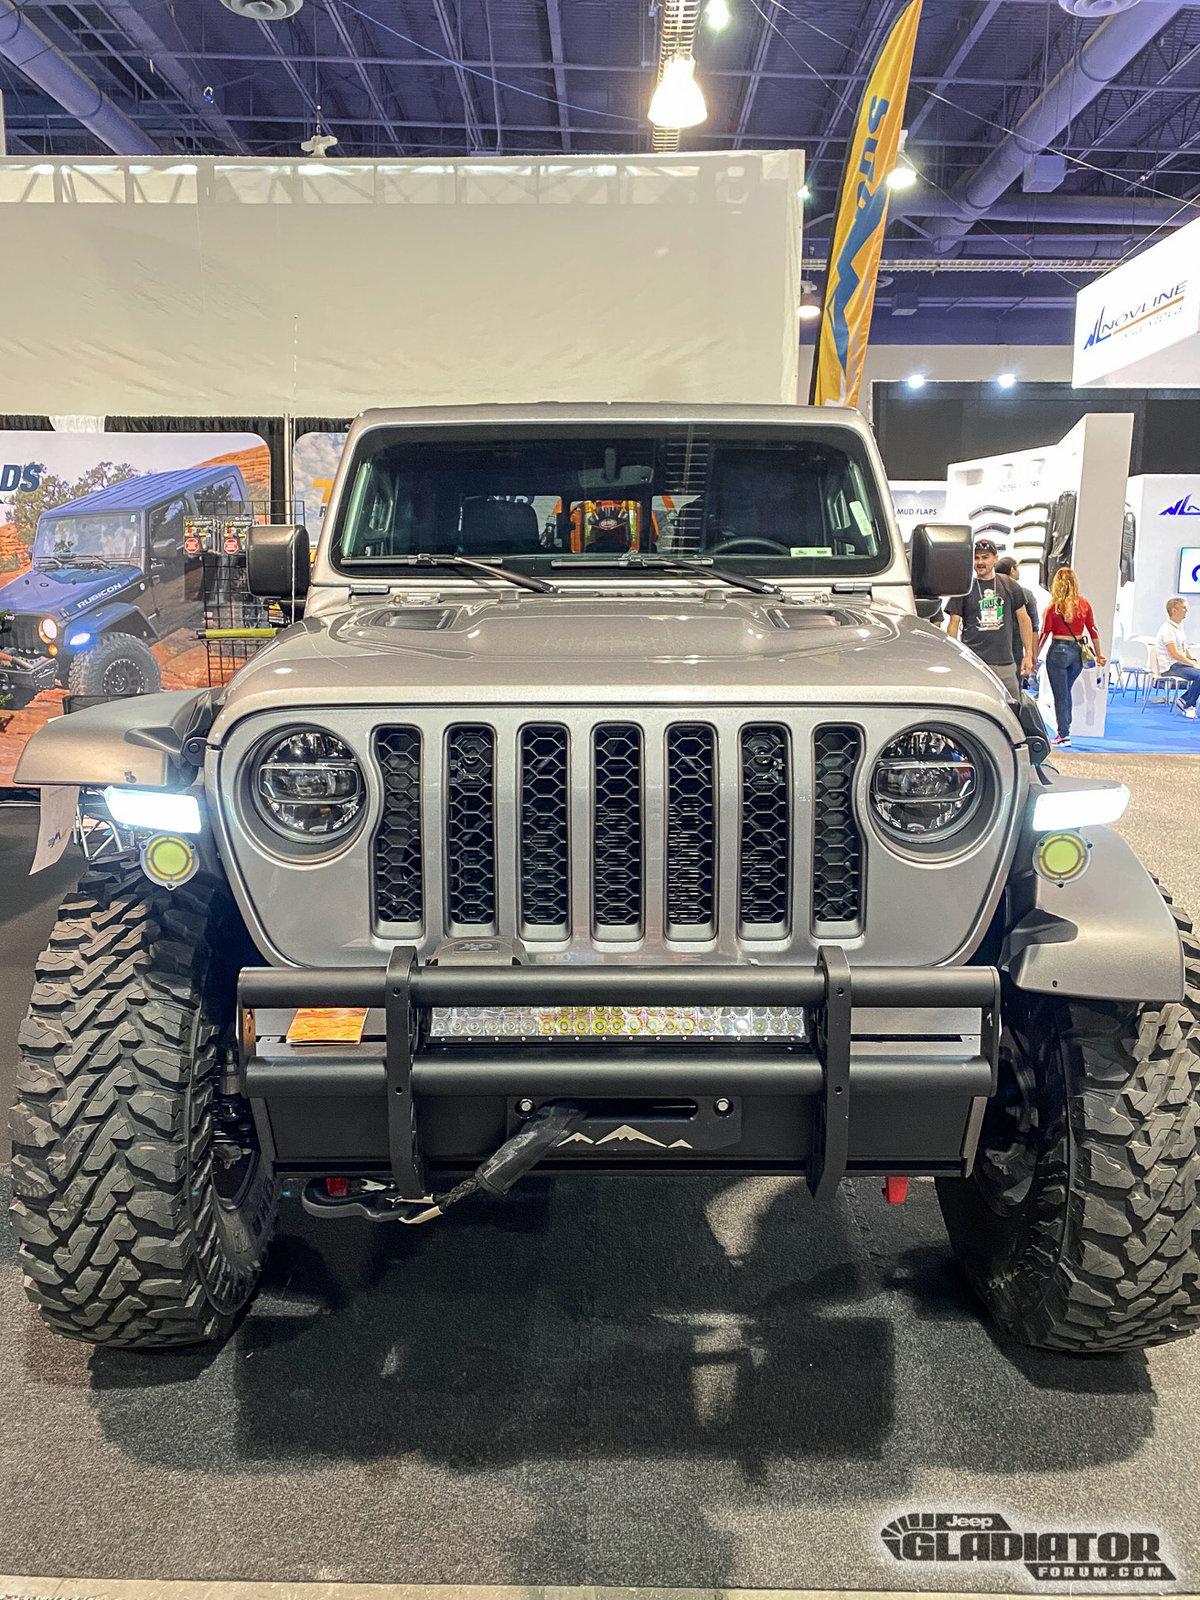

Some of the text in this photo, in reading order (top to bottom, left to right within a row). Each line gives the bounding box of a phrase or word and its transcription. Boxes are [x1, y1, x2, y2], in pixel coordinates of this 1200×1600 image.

[896, 508, 938, 516] MUD FLAPS
[76, 582, 122, 609] RUBICON
